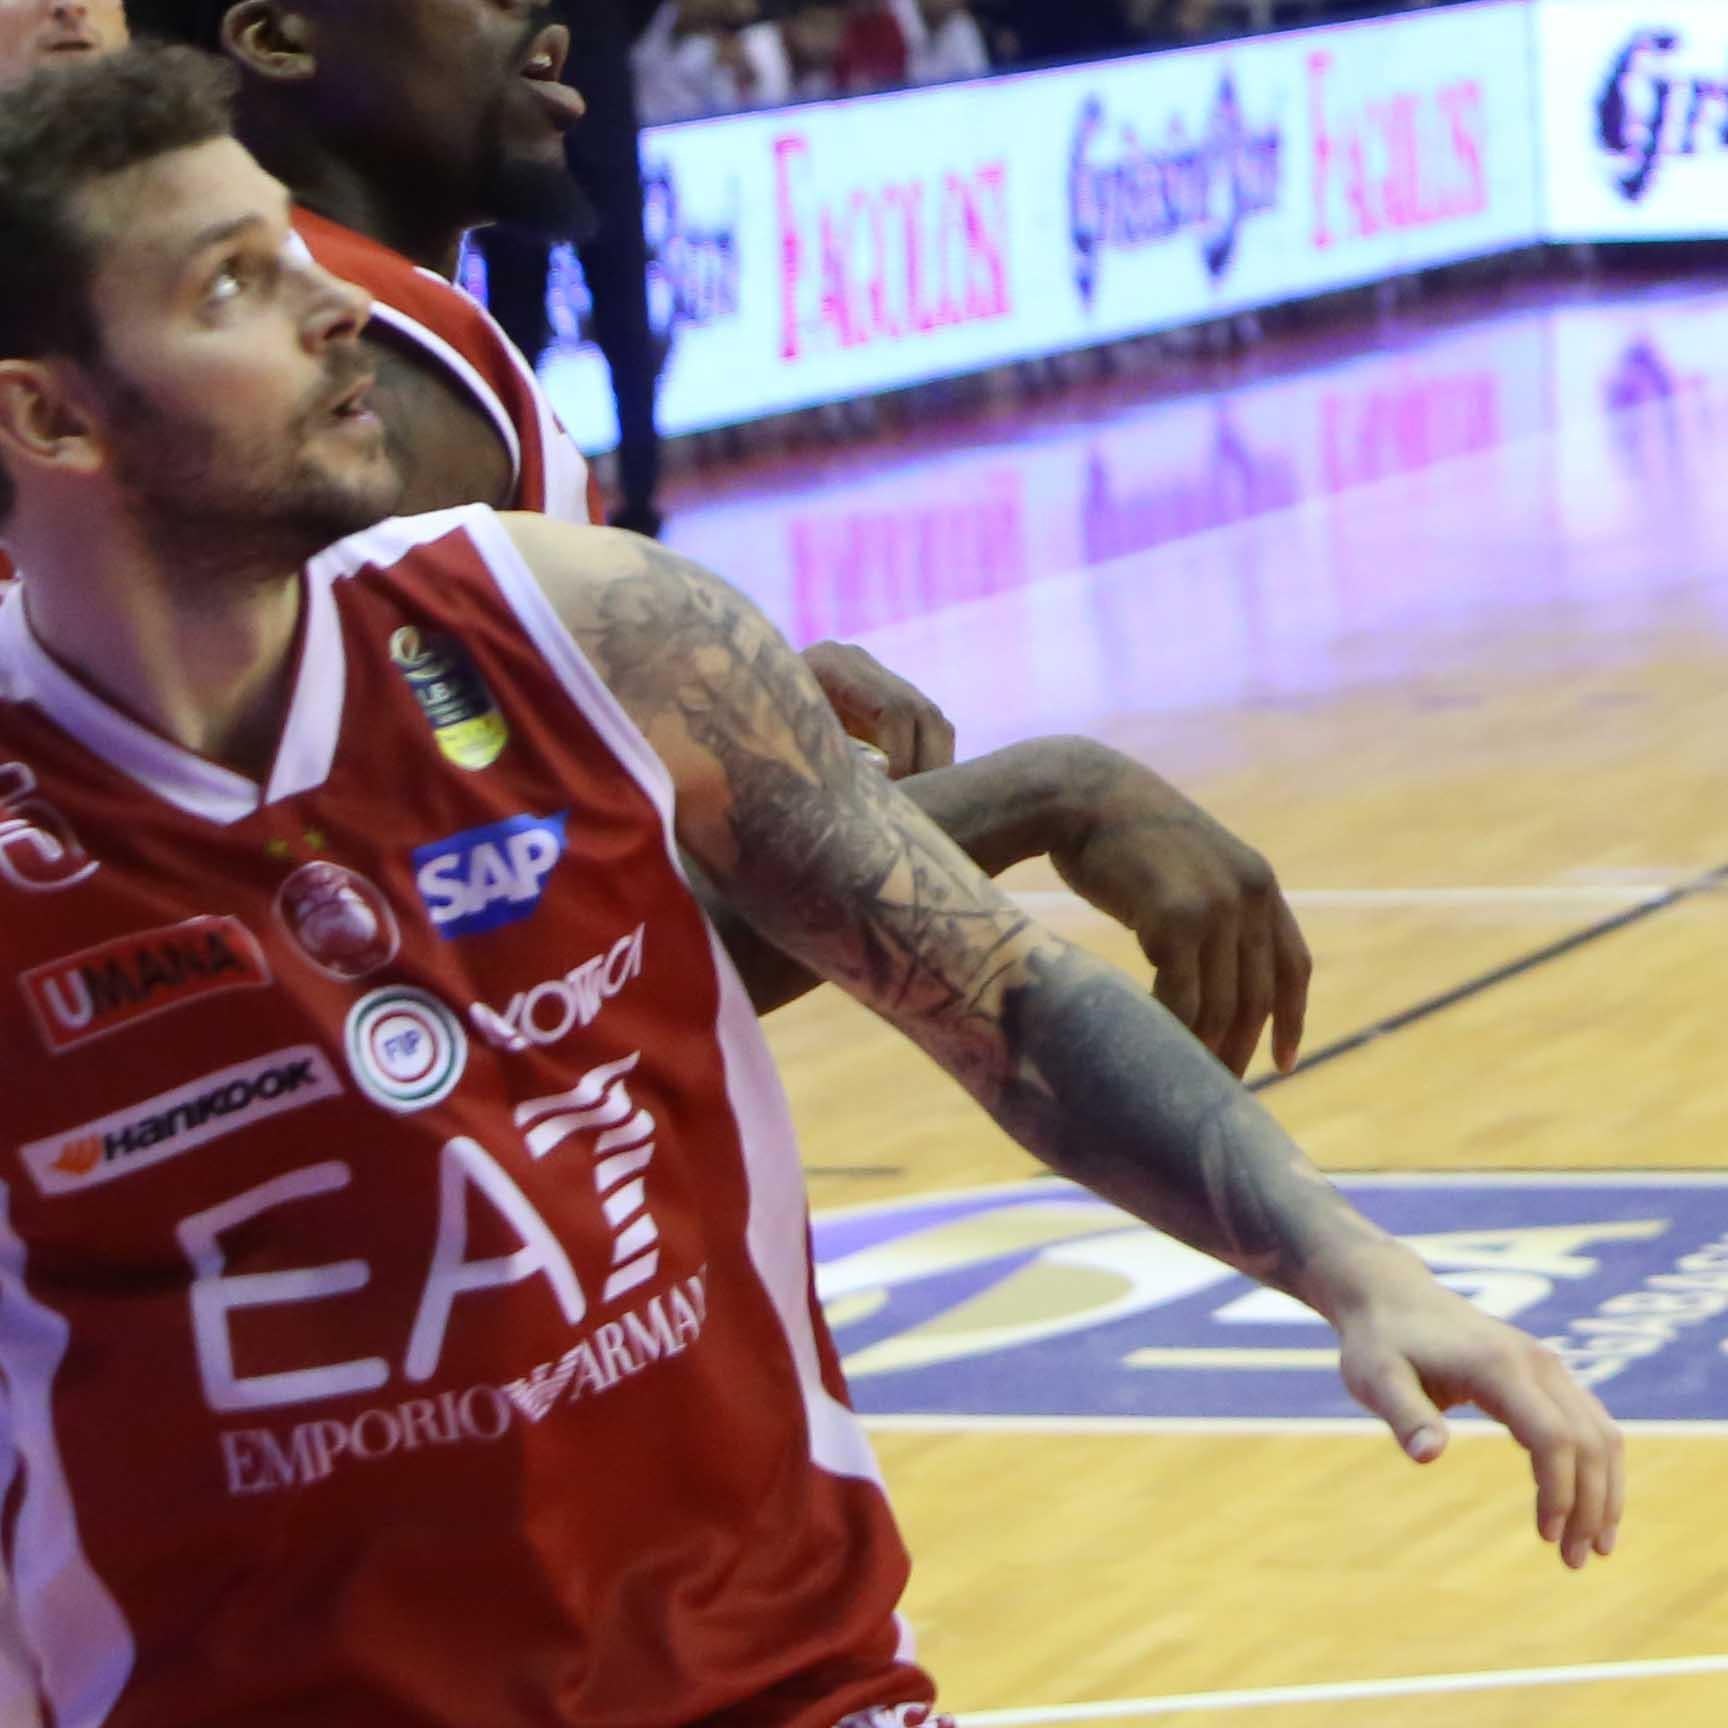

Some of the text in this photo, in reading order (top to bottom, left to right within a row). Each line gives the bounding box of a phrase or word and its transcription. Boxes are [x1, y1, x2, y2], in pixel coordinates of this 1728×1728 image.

[416, 826, 562, 926] SAP
[44, 928, 246, 1030] UMANA
[383, 1026, 424, 1064] FIP
[176, 1050, 660, 1414] EA7
[219, 1383, 511, 1496] EMPORIO
